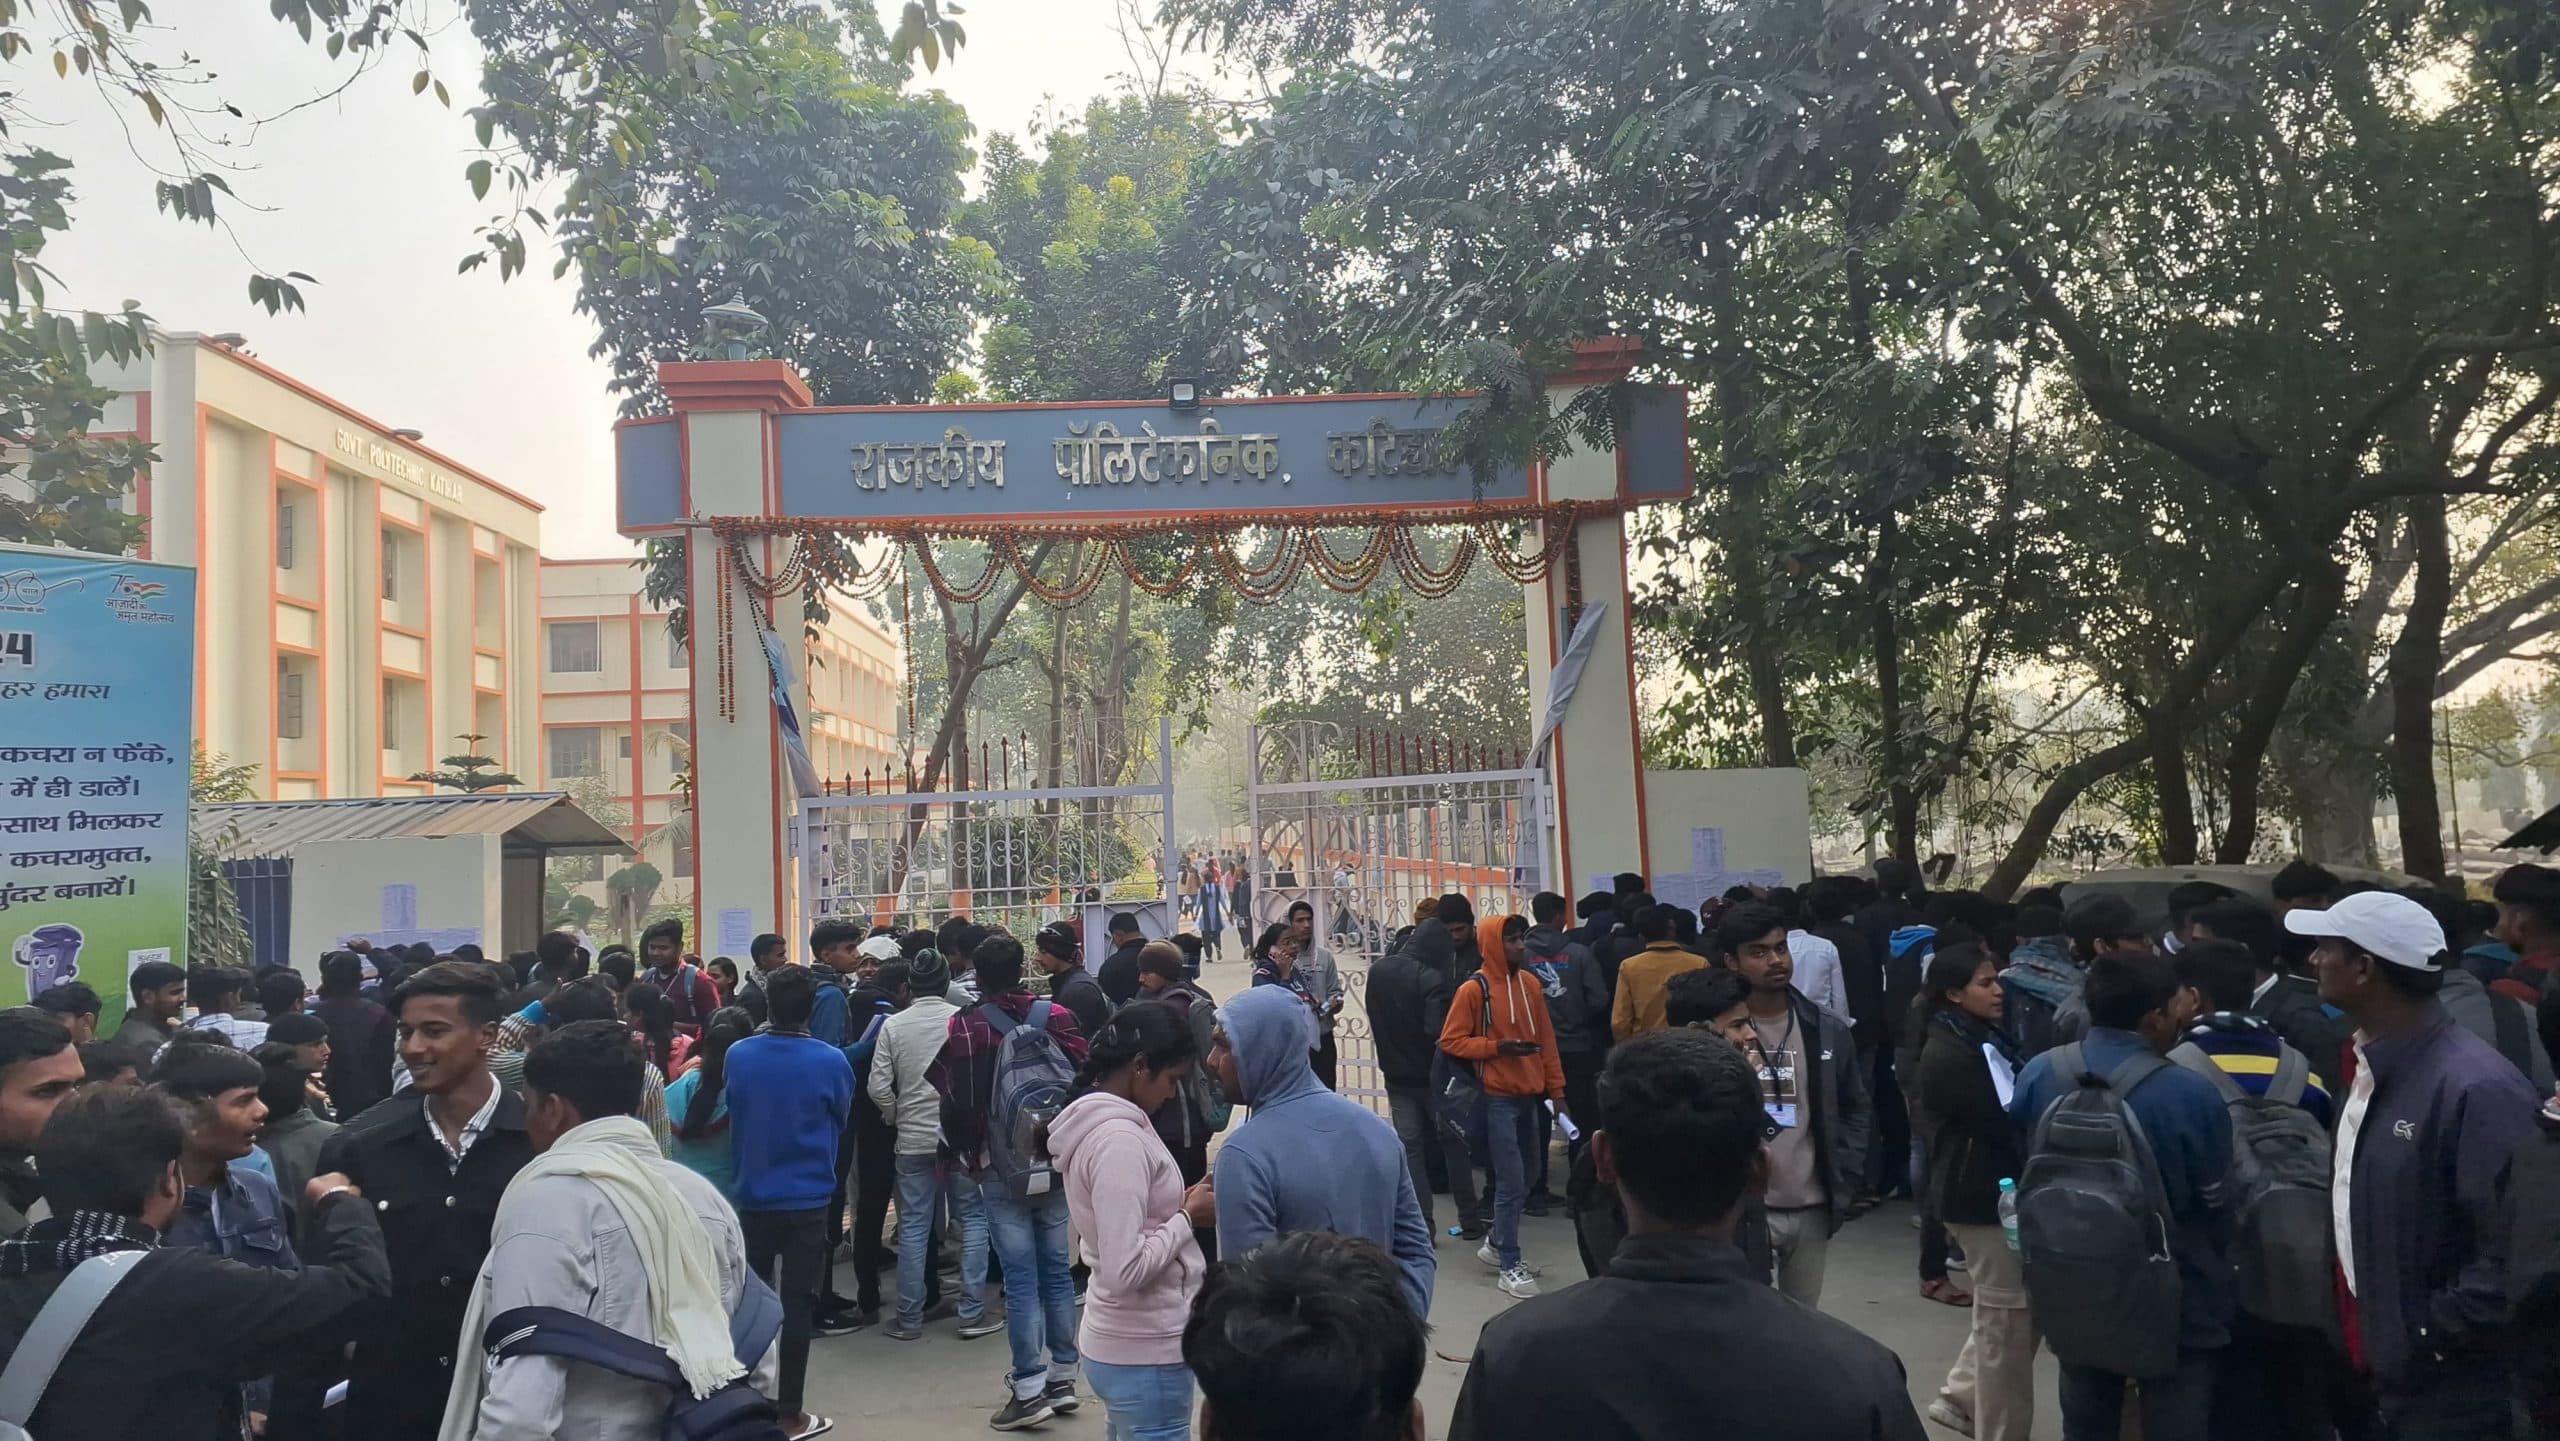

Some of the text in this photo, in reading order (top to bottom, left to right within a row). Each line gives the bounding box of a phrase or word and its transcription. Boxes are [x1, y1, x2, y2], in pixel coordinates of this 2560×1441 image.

[851, 426, 1005, 489] राजकीय
[1327, 416, 1457, 478] कटिह
[369, 444, 424, 487] POLYTECHNIC
[0, 633, 32, 665] 4
[0, 681, 111, 700] हर हमारा
[0, 742, 174, 764] कचरा न फेंके,
[10, 776, 39, 798] में
[44, 776, 73, 798] ही
[0, 810, 163, 833] साथ मिलकर
[9, 846, 152, 870] कचरामुक्त,
